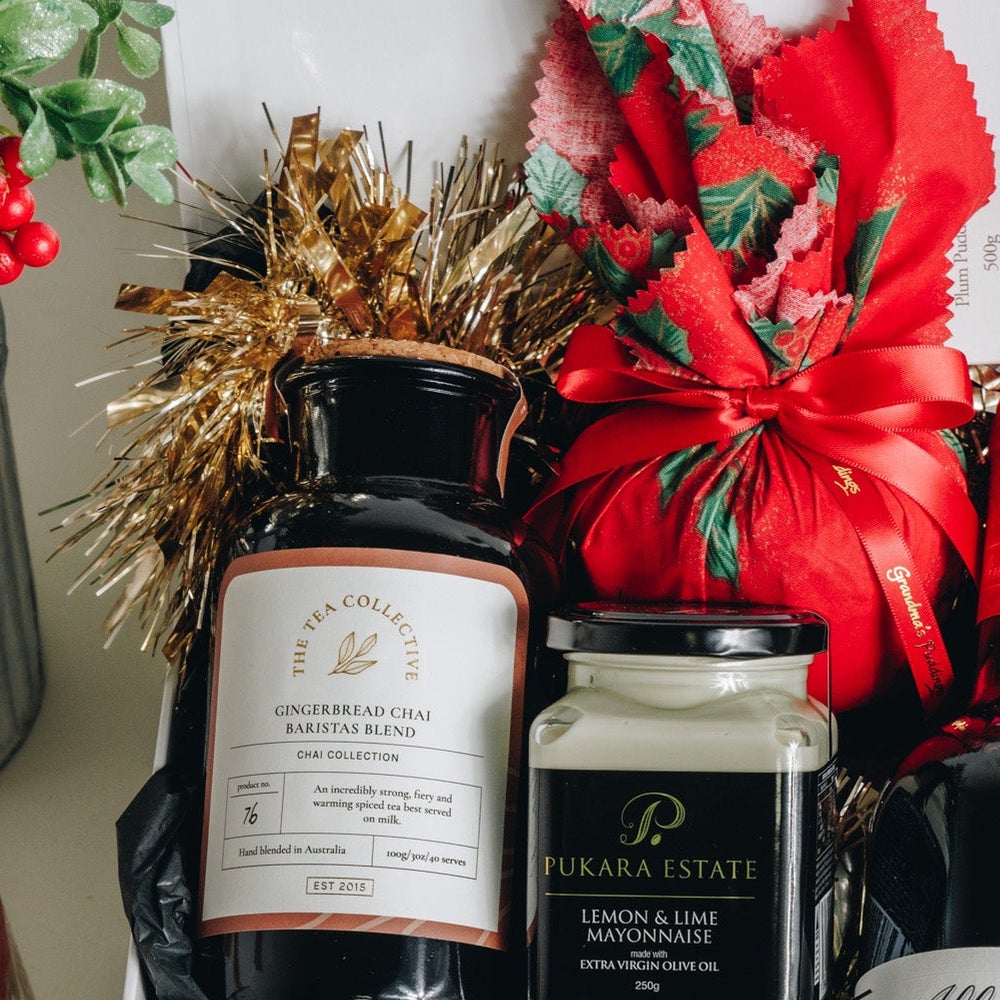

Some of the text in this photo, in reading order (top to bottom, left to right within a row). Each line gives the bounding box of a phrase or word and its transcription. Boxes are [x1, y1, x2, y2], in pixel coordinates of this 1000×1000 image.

[955, 268, 969, 306] Plum
[292, 594, 419, 681] THE TEA COLLECTIVE
[275, 704, 431, 721] GINGERBREAD CHAI
[286, 721, 416, 738] BARISTAS BLEND
[297, 750, 399, 762] CHAI COLLECTION
[314, 785, 327, 795] An
[330, 784, 376, 799] incredibly
[414, 789, 435, 803] fiery
[437, 794, 452, 803] and
[313, 799, 451, 817] warming spiced tea best served
[363, 816, 375, 824] on
[239, 845, 346, 857] Hand blended in Australia
[442, 857, 466, 867] serves
[544, 856, 757, 880] PUKARA ESTATE
[314, 881, 366, 892] EST 2015
[582, 909, 718, 926] LEMON & LIME
[587, 928, 712, 944] MAYONNAISE
[631, 950, 667, 959] made with
[580, 960, 719, 972] EXTRA VIRGIN OLIVE OIL
[635, 981, 660, 992] 250g
